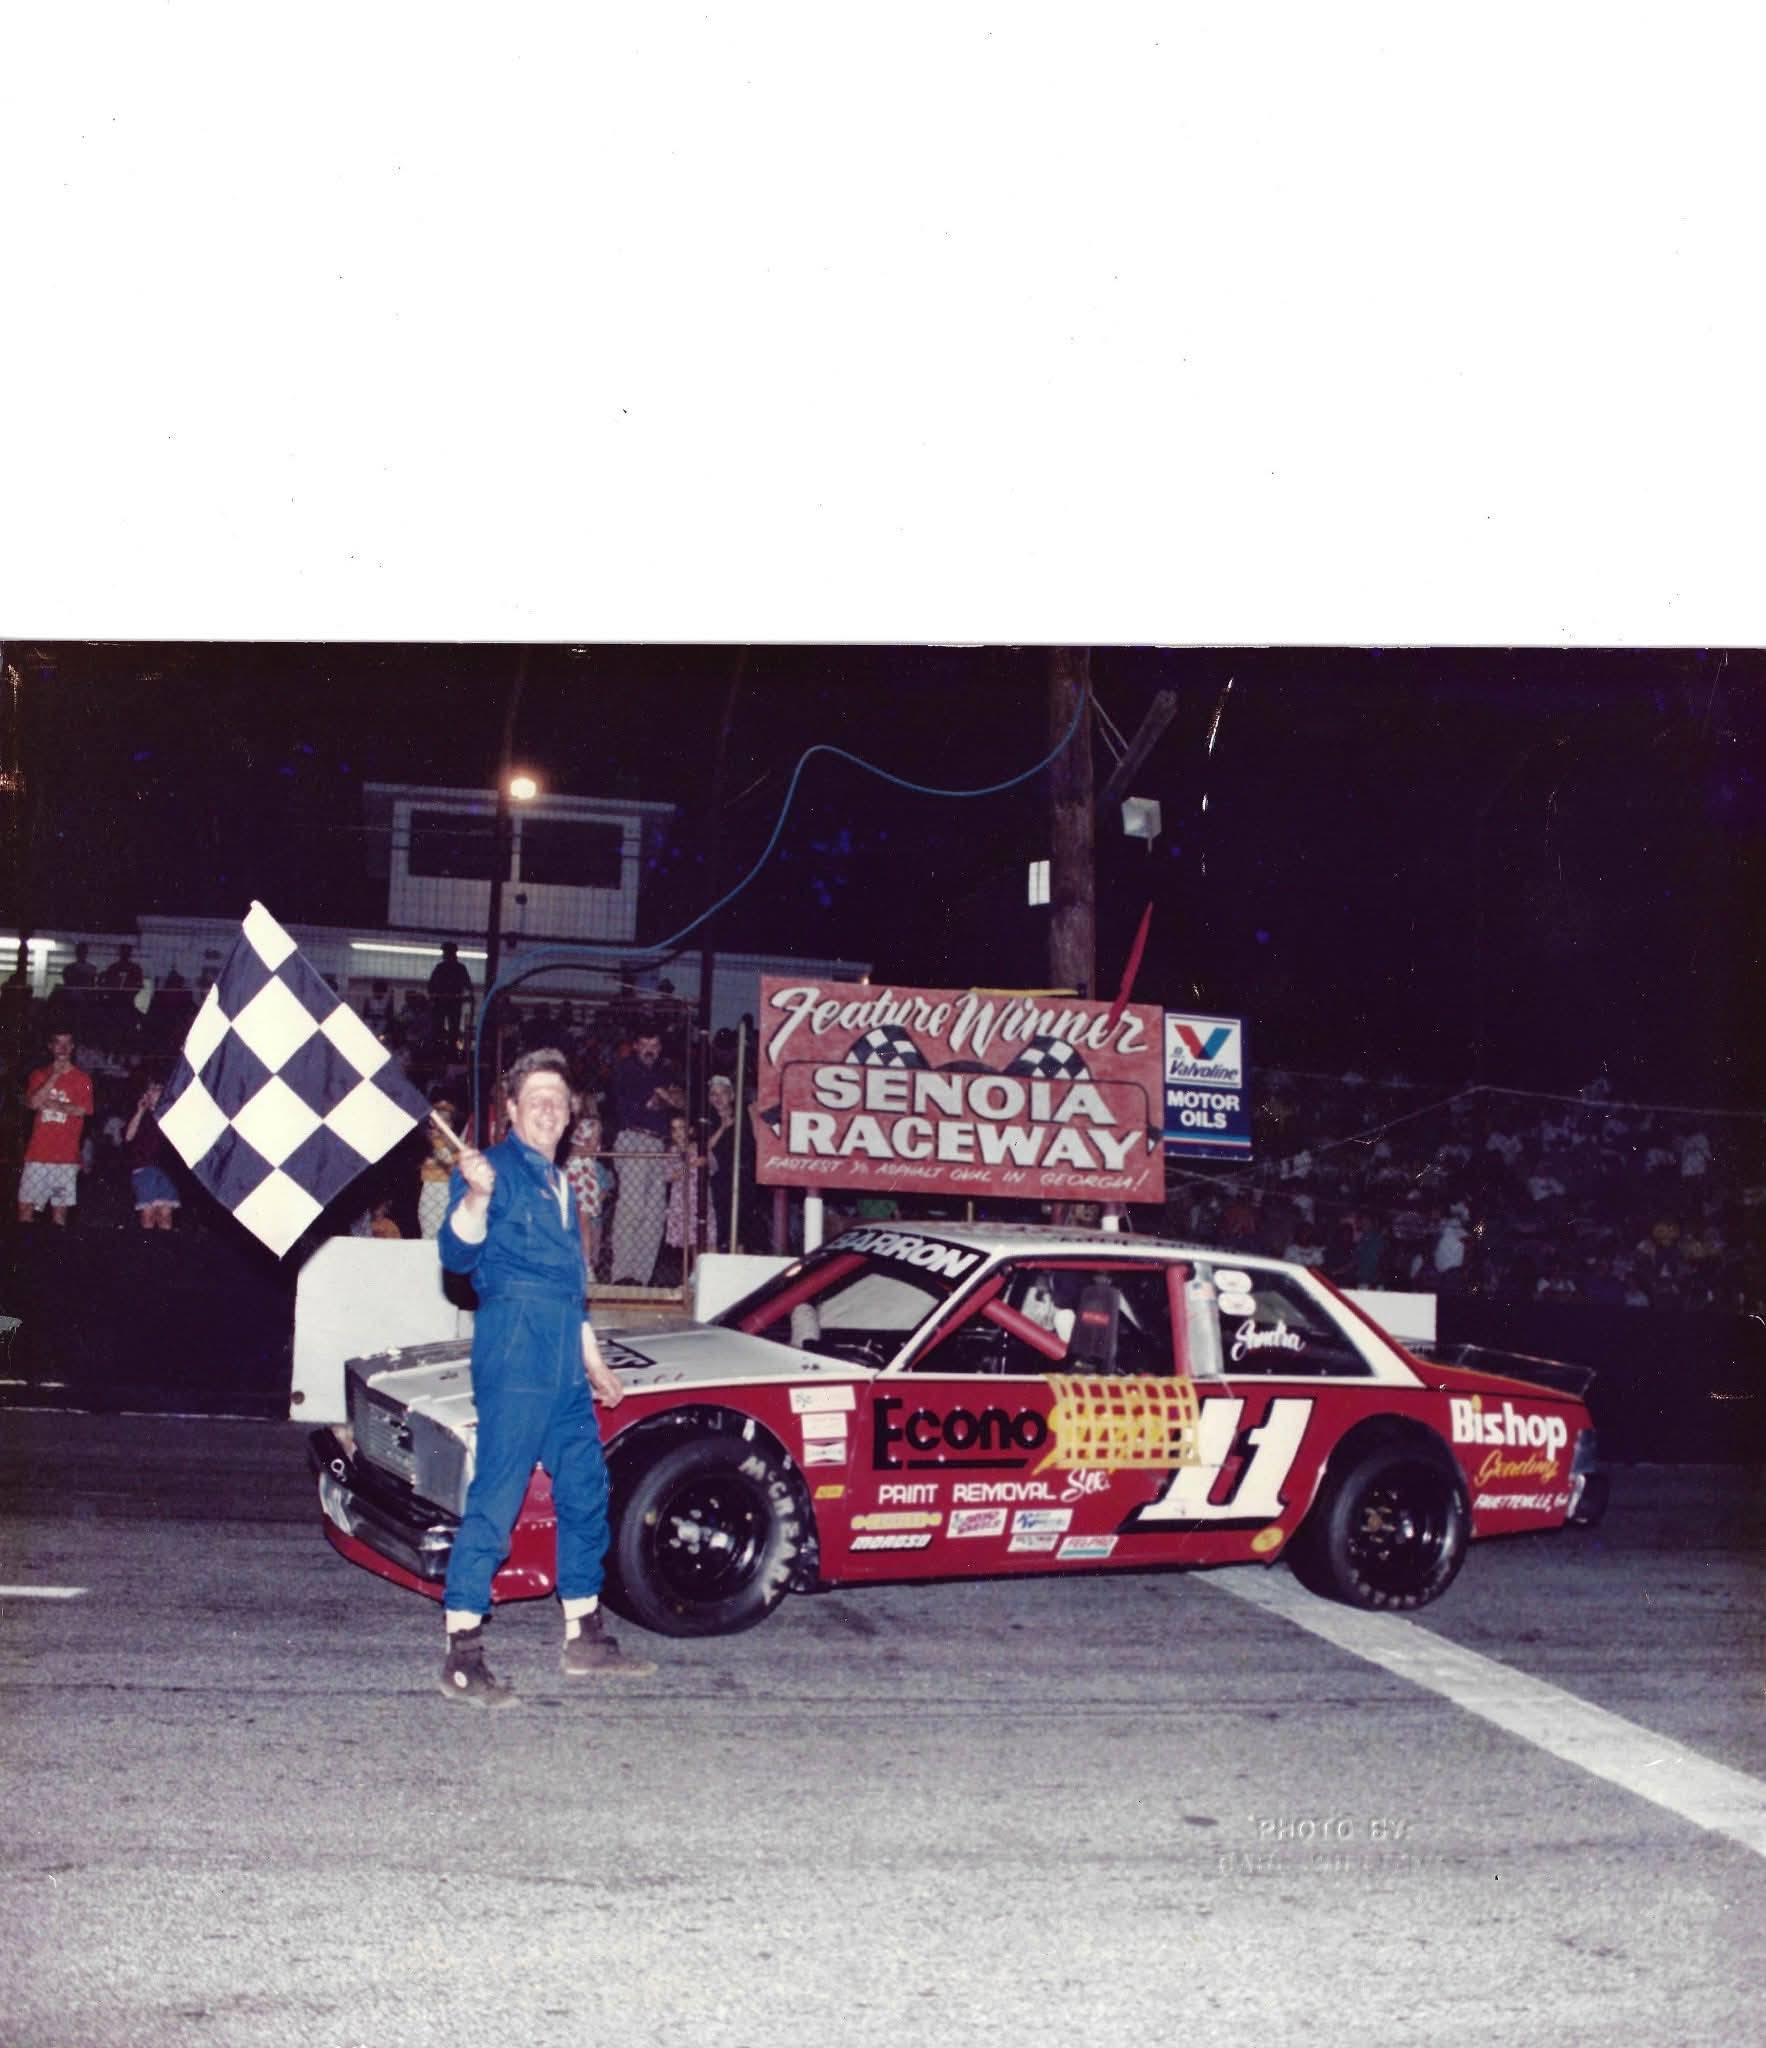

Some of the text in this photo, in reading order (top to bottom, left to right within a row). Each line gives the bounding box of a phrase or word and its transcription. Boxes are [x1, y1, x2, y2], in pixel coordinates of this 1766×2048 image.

[767, 987, 1149, 1067] Feature Winner
[813, 1066, 1117, 1125] SENOIA
[1169, 1059, 1238, 1081] Valvoline
[1167, 1090, 1240, 1112] MOTOR
[1180, 1109, 1227, 1129] OILS
[789, 1110, 1143, 1170] RACEWAY
[765, 1156, 843, 1174] FASTEST
[875, 1162, 945, 1179] ASPHALT
[949, 1168, 992, 1183] OVAL
[1002, 1169, 1026, 1184] IN
[1040, 1169, 1149, 1193] GEORGIA!
[825, 1230, 981, 1279] BARRON
[872, 1397, 1050, 1470] Econo
[1450, 1394, 1568, 1463] Bishop
[1137, 1397, 1314, 1521] 11
[878, 1483, 939, 1505] PAINT
[952, 1482, 1057, 1503] REMOVAL
